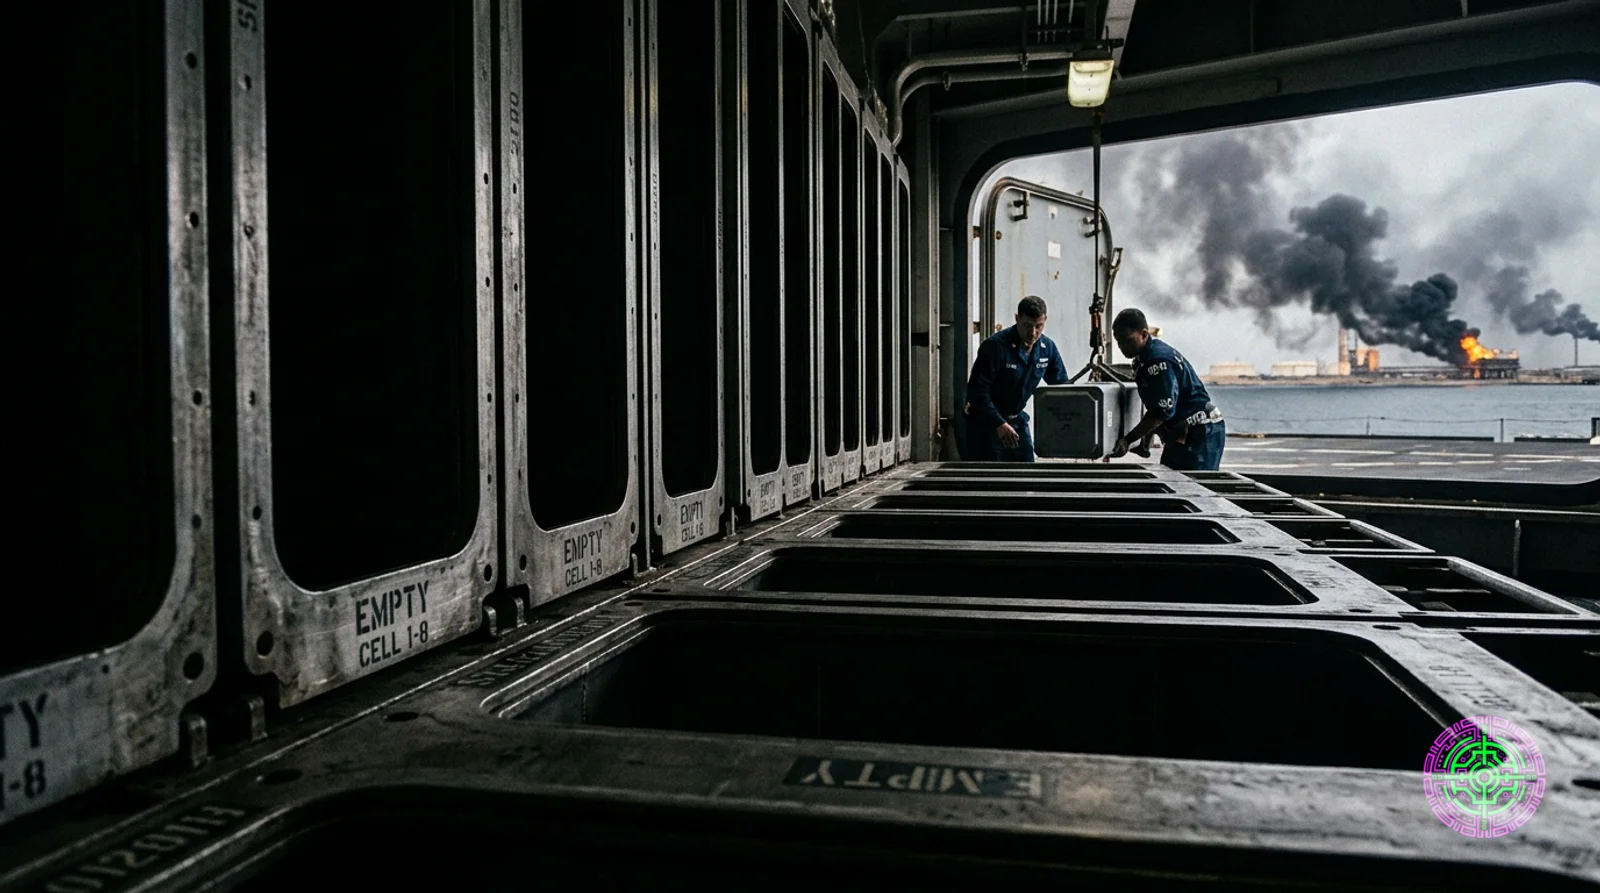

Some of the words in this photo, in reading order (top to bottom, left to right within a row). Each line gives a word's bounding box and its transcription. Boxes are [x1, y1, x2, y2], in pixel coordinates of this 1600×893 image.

[564, 529, 602, 564] EMPTY
[565, 564, 588, 587] CELL
[590, 558, 602, 578] 1-8
[356, 580, 429, 635] EMPTY
[360, 631, 402, 668] CELL
[407, 620, 428, 649] 1-8
